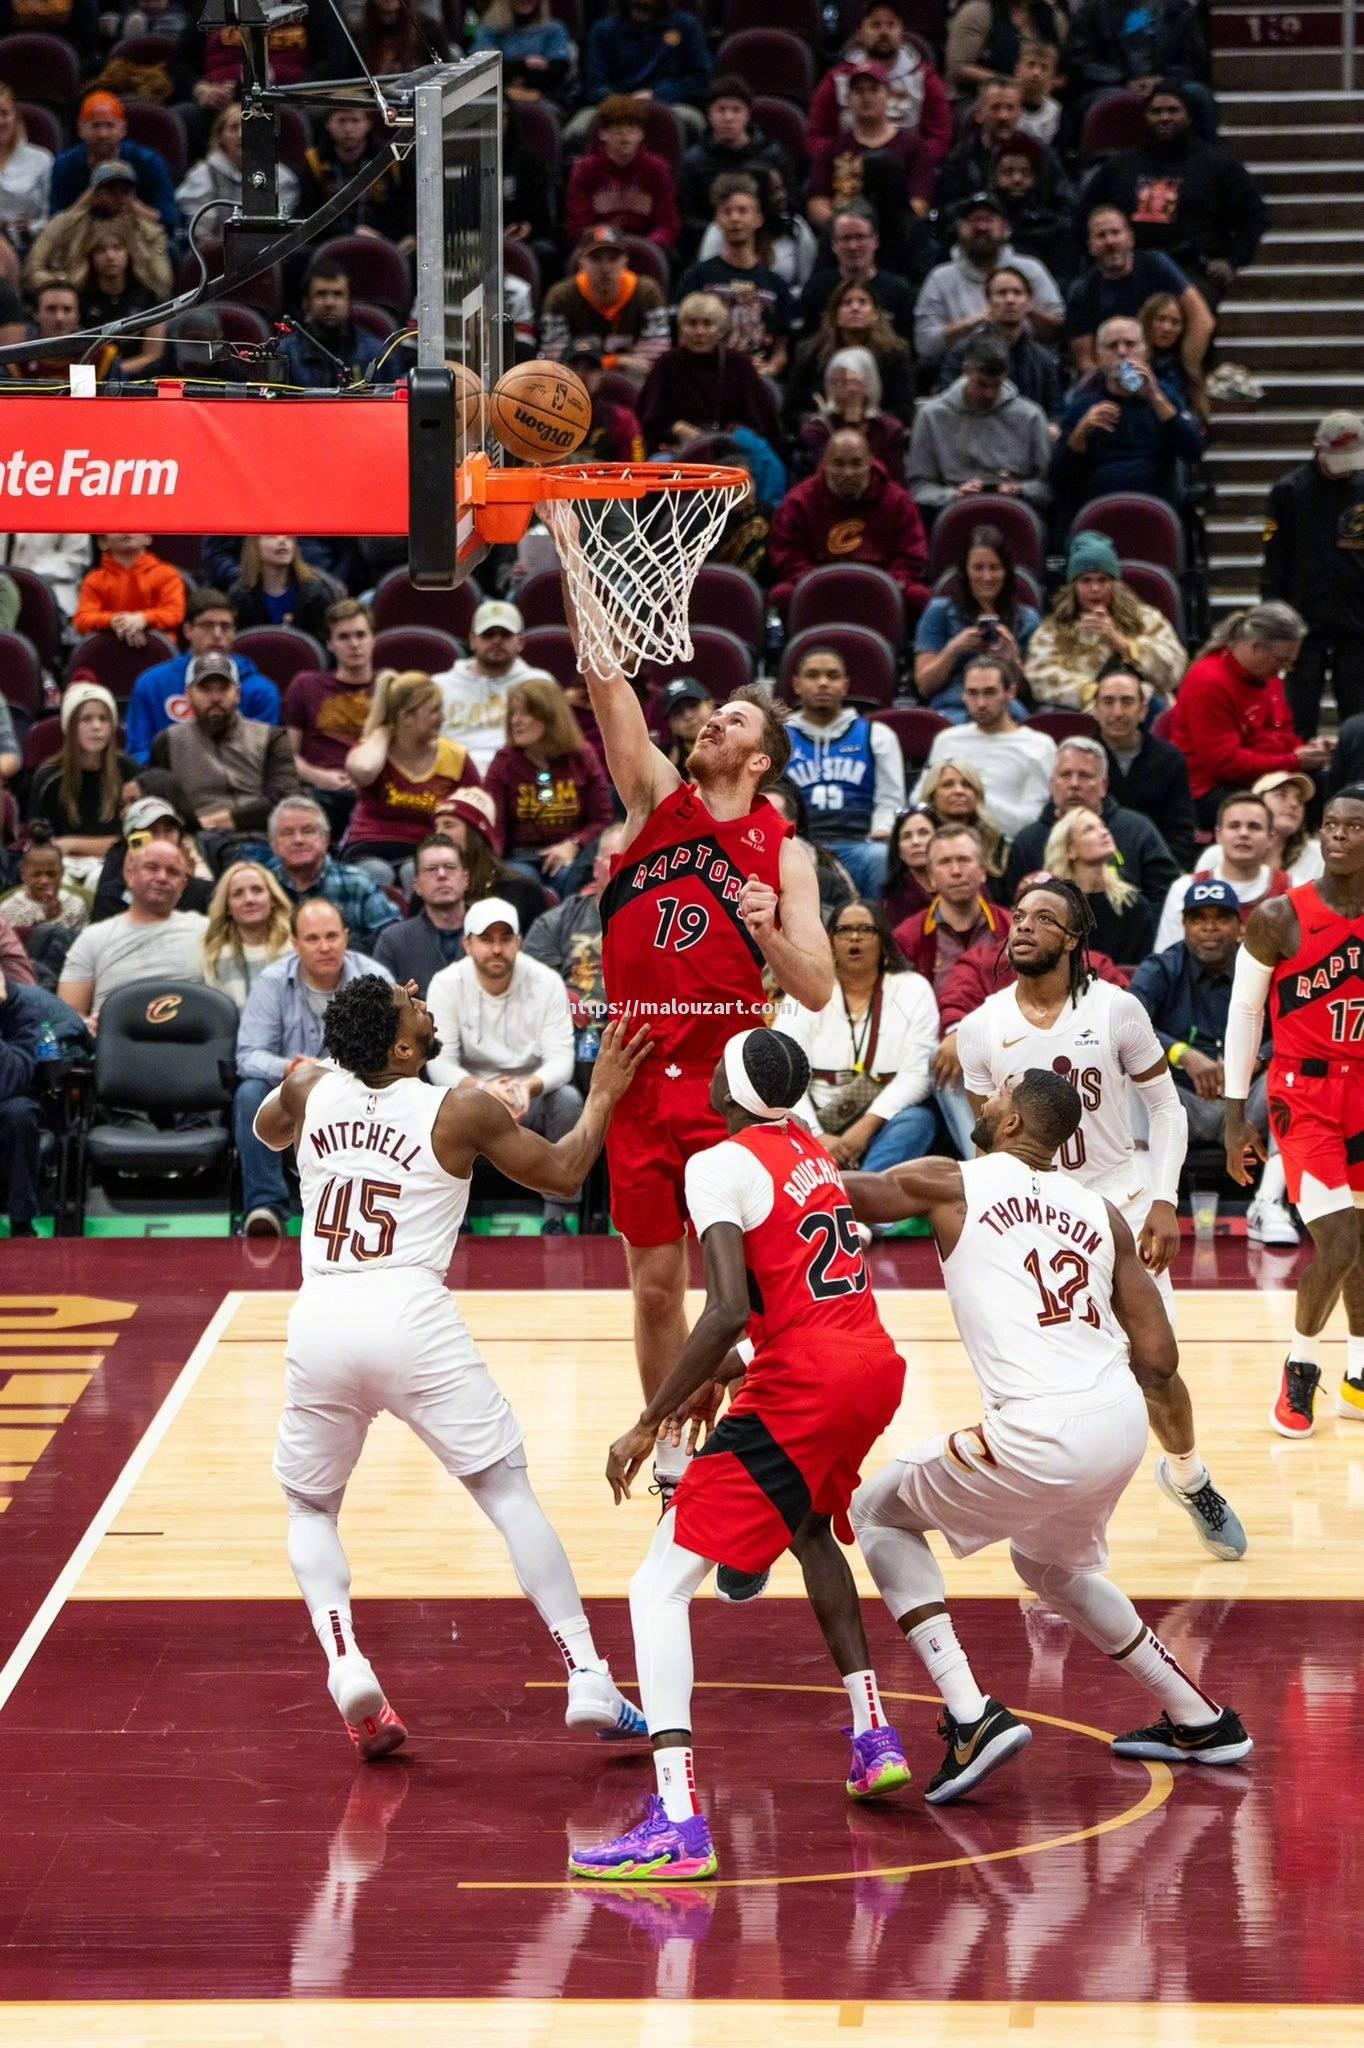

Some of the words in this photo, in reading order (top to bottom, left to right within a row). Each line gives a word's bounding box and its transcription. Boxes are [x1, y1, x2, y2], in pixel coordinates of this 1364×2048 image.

[514, 406, 576, 448] Wilson
[57, 449, 179, 497] Farm
[632, 844, 745, 920] RAPTOR
[1194, 885, 1225, 900] DG
[653, 896, 710, 952] 19
[310, 1121, 422, 1172] MITCHELL
[314, 1176, 402, 1263] 45
[978, 1196, 1104, 1256] THOMPSON
[796, 1205, 868, 1302] 25
[1023, 1247, 1101, 1330] 12
